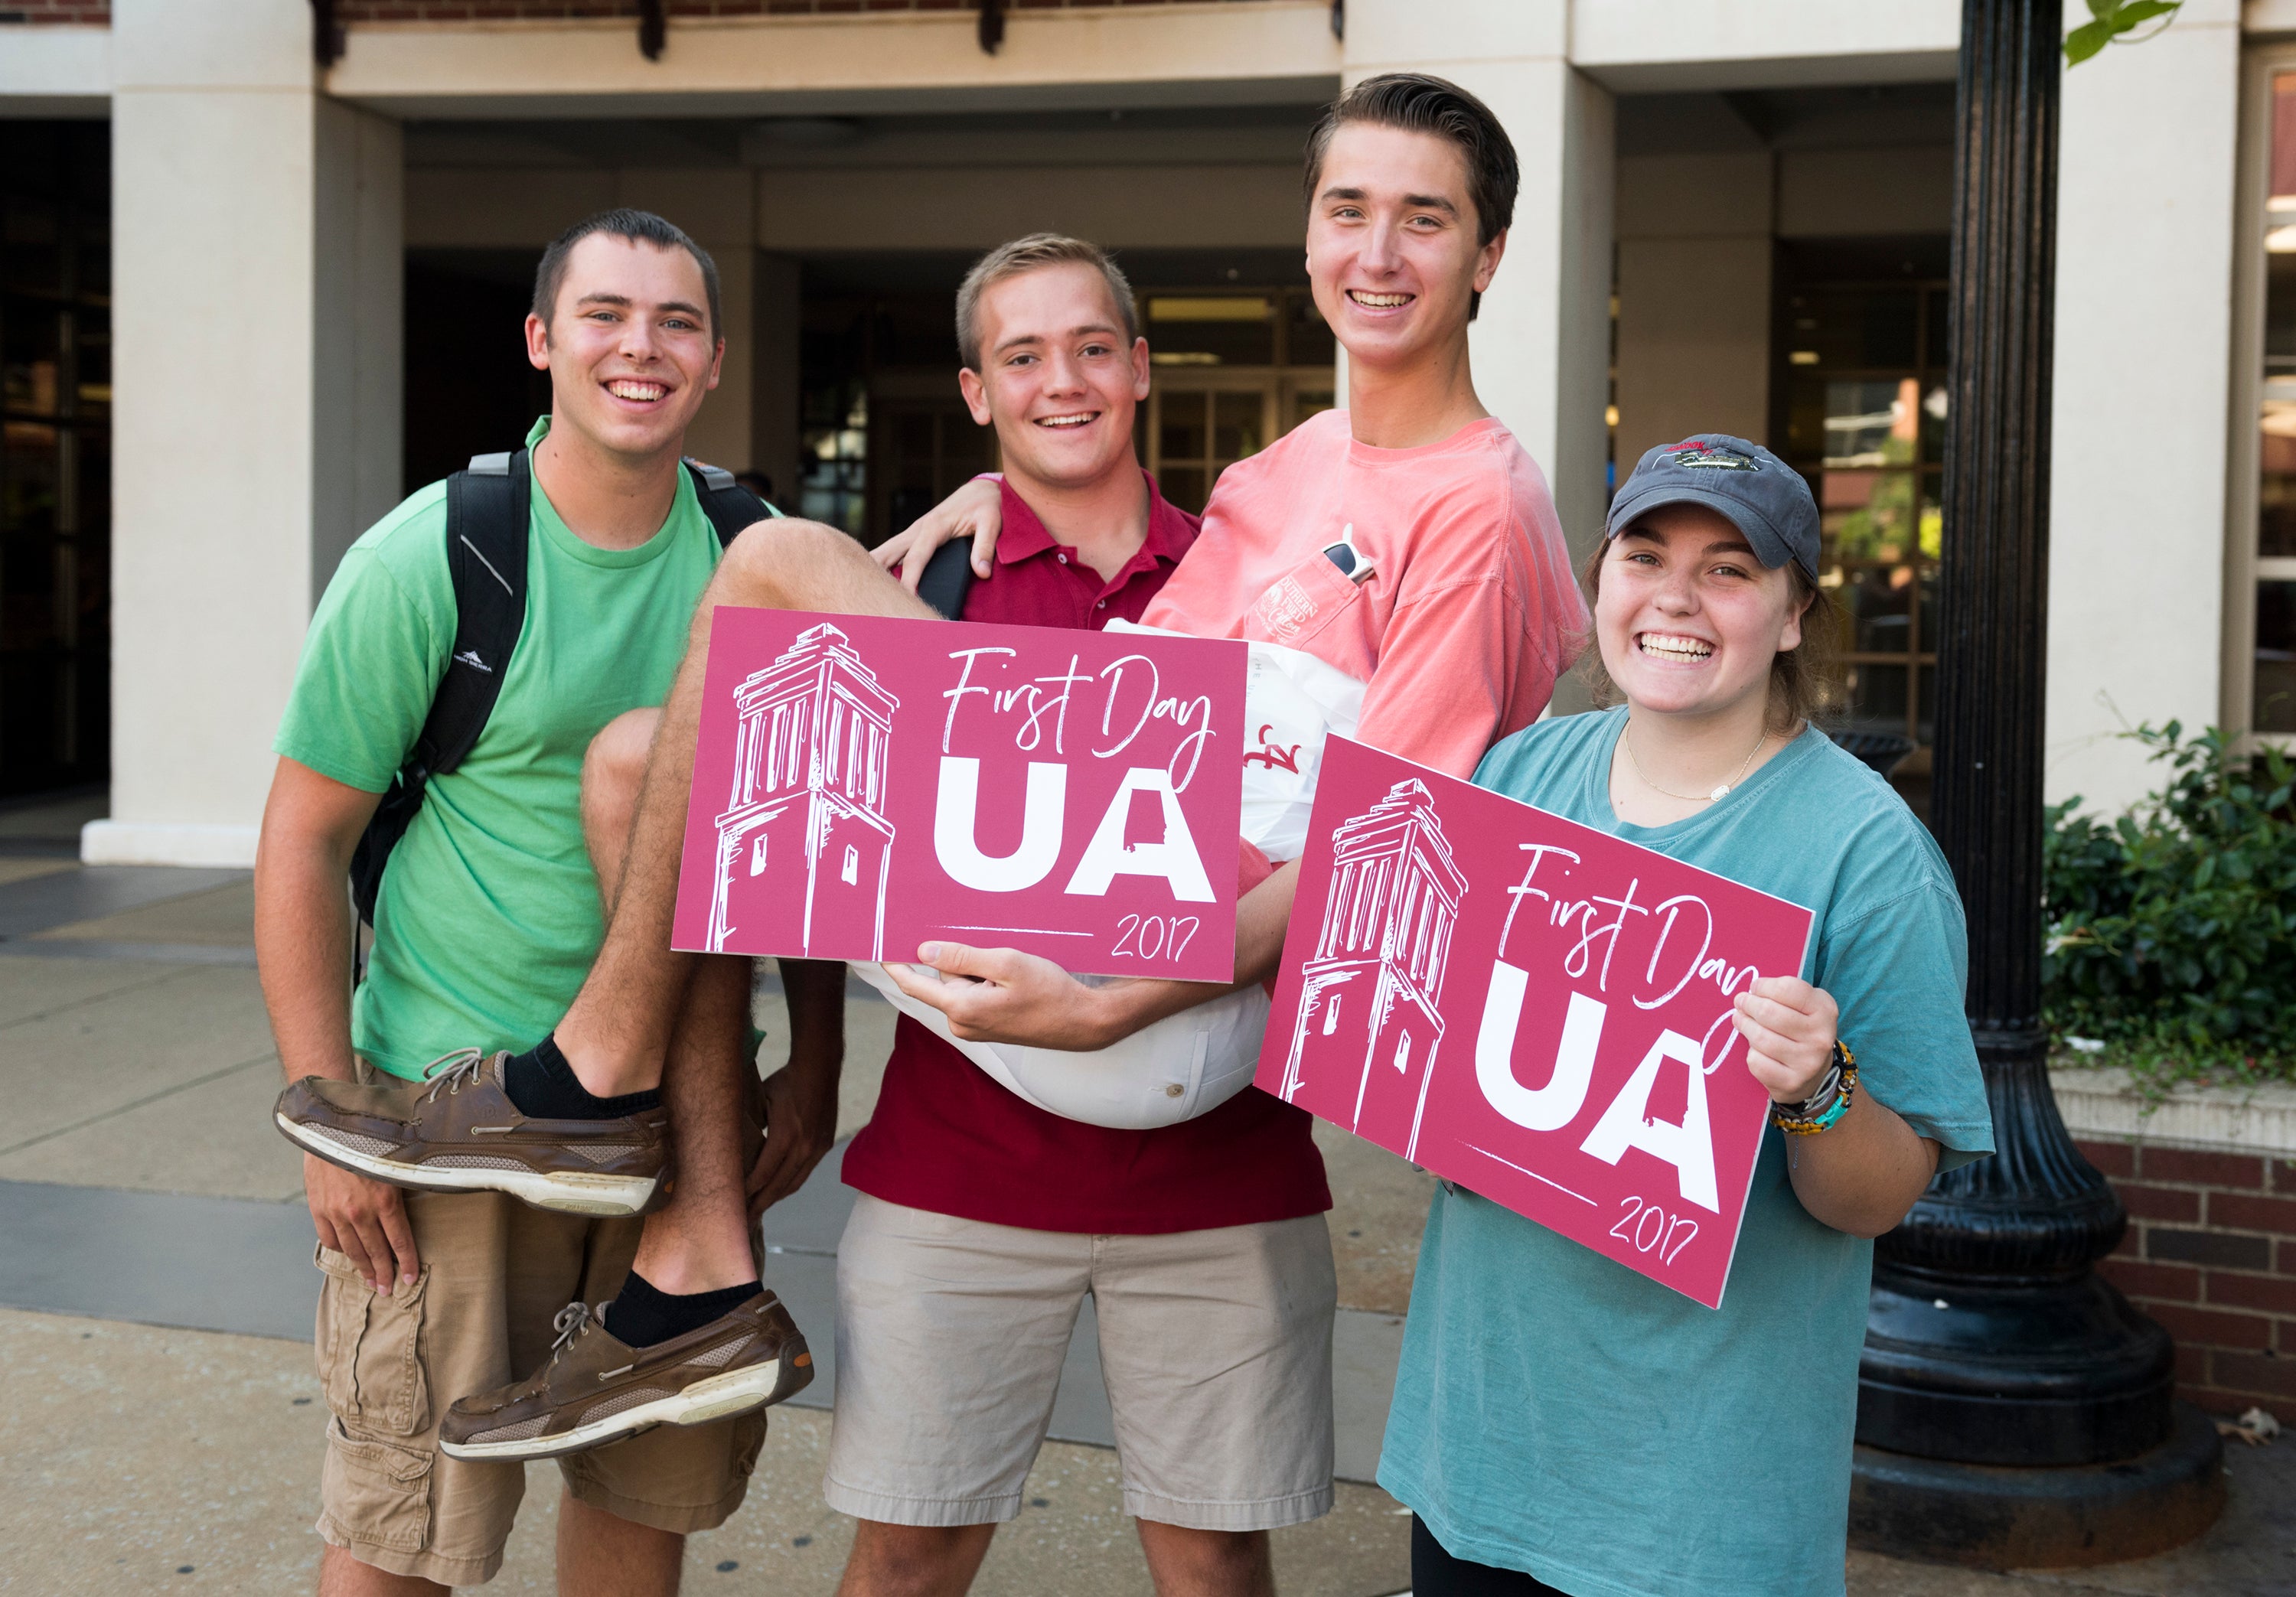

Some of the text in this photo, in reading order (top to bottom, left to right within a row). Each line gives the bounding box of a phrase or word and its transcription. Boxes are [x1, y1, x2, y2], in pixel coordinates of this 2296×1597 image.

[1280, 575, 1318, 618] OUTHERN
[1280, 596, 1306, 622] FRIED
[468, 660, 492, 673] SIERRA
[942, 647, 1217, 794] First Day
[933, 756, 1217, 903] UA
[1111, 914, 1199, 963] 2017
[1498, 843, 1648, 992] First
[1474, 959, 1720, 1214] UA
[1609, 1195, 1698, 1266] 2017
